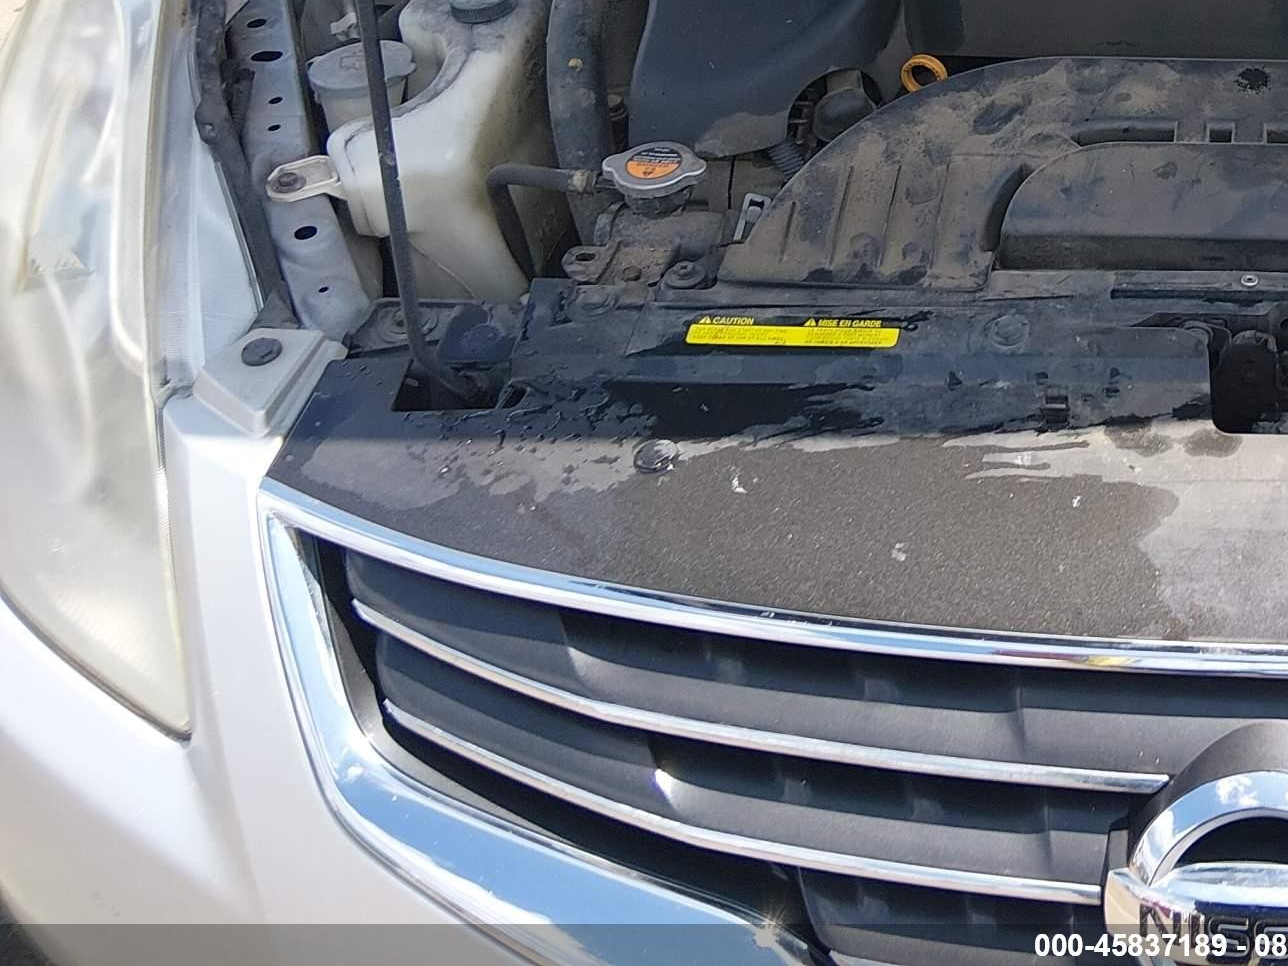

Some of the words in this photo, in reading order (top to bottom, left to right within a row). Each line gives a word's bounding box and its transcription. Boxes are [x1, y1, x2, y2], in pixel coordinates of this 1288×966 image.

[711, 316, 755, 326] CAUTION
[817, 318, 839, 327] MISE
[839, 319, 853, 327] EN
[852, 319, 883, 328] GARDE
